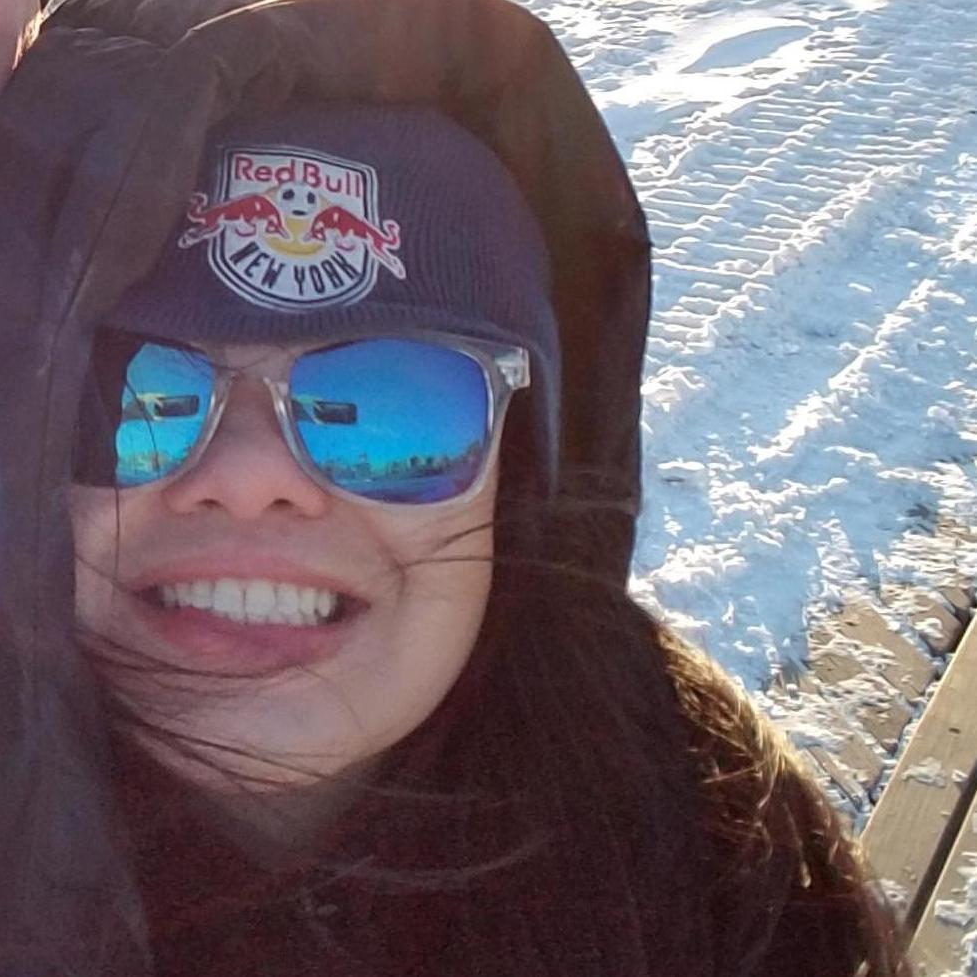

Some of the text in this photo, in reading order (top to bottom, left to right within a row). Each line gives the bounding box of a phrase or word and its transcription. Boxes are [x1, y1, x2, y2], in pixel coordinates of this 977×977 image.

[234, 156, 361, 198] Red Bull
[229, 241, 360, 296] NEW YORK
